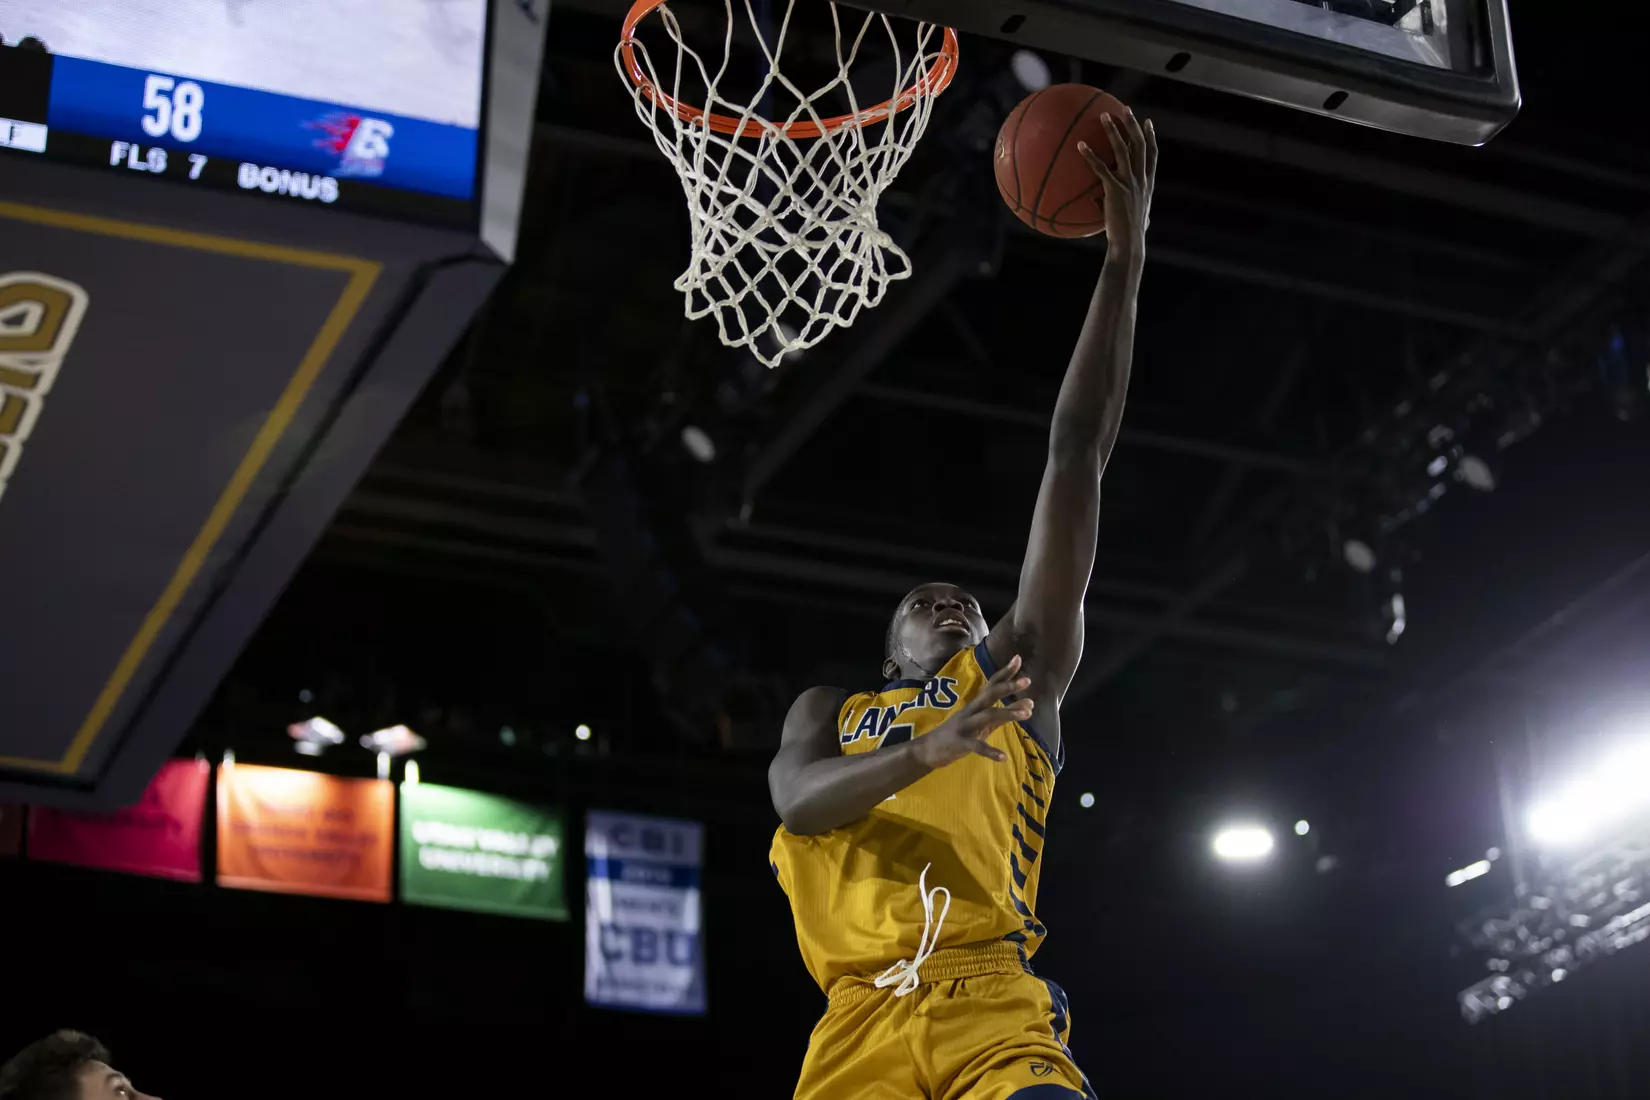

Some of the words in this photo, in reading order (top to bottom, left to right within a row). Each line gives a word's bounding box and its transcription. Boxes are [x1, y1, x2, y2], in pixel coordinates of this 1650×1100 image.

[140, 73, 205, 142] 58
[109, 140, 168, 173] FLS
[188, 153, 208, 180] 7
[237, 161, 340, 204] BONUS
[840, 676, 959, 745] LANRS
[600, 923, 695, 967] CBU
